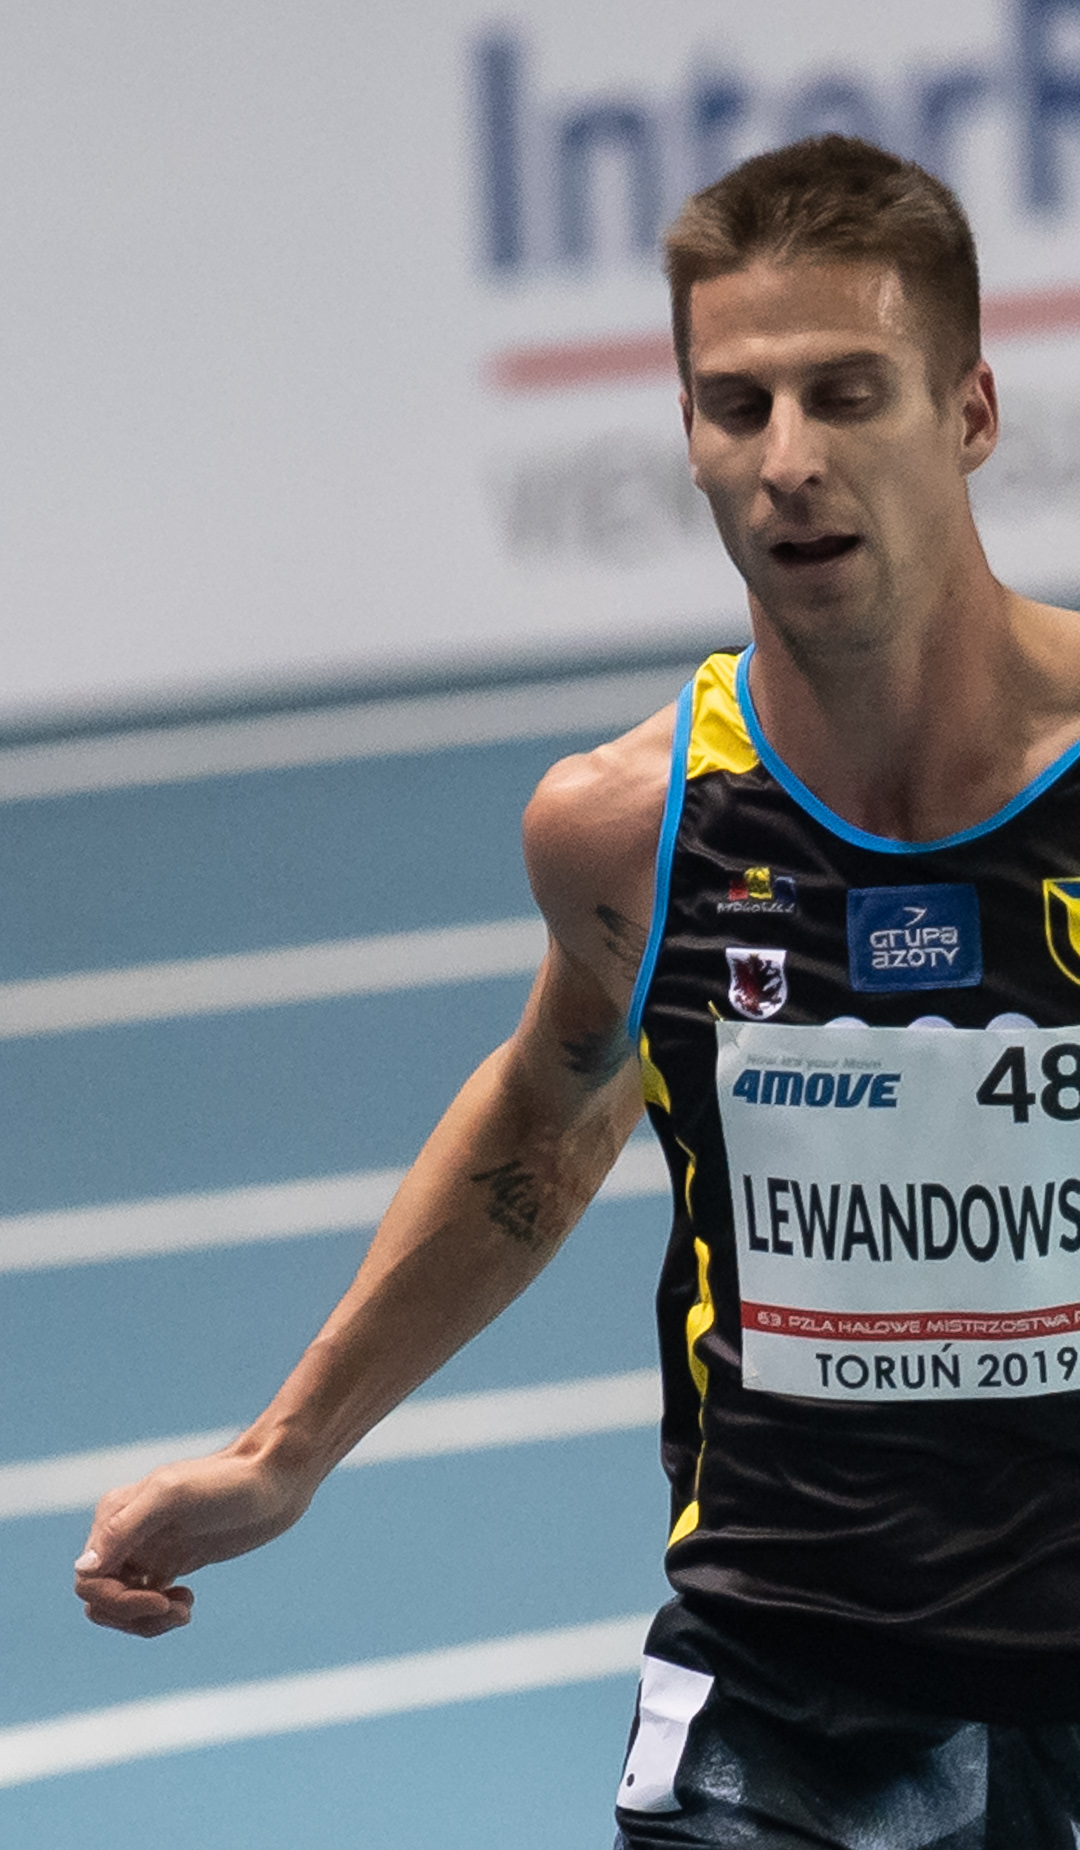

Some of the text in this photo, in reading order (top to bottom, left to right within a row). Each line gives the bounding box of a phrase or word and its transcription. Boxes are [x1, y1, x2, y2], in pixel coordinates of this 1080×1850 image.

[732, 1069, 901, 1109] 4MOVE
[788, 1315, 835, 1333] PZLA
[838, 1320, 921, 1335] HALOWE
[926, 1313, 1071, 1334] MISTRZOSTWA
[815, 1343, 1079, 1390] TORUŃ 2019
